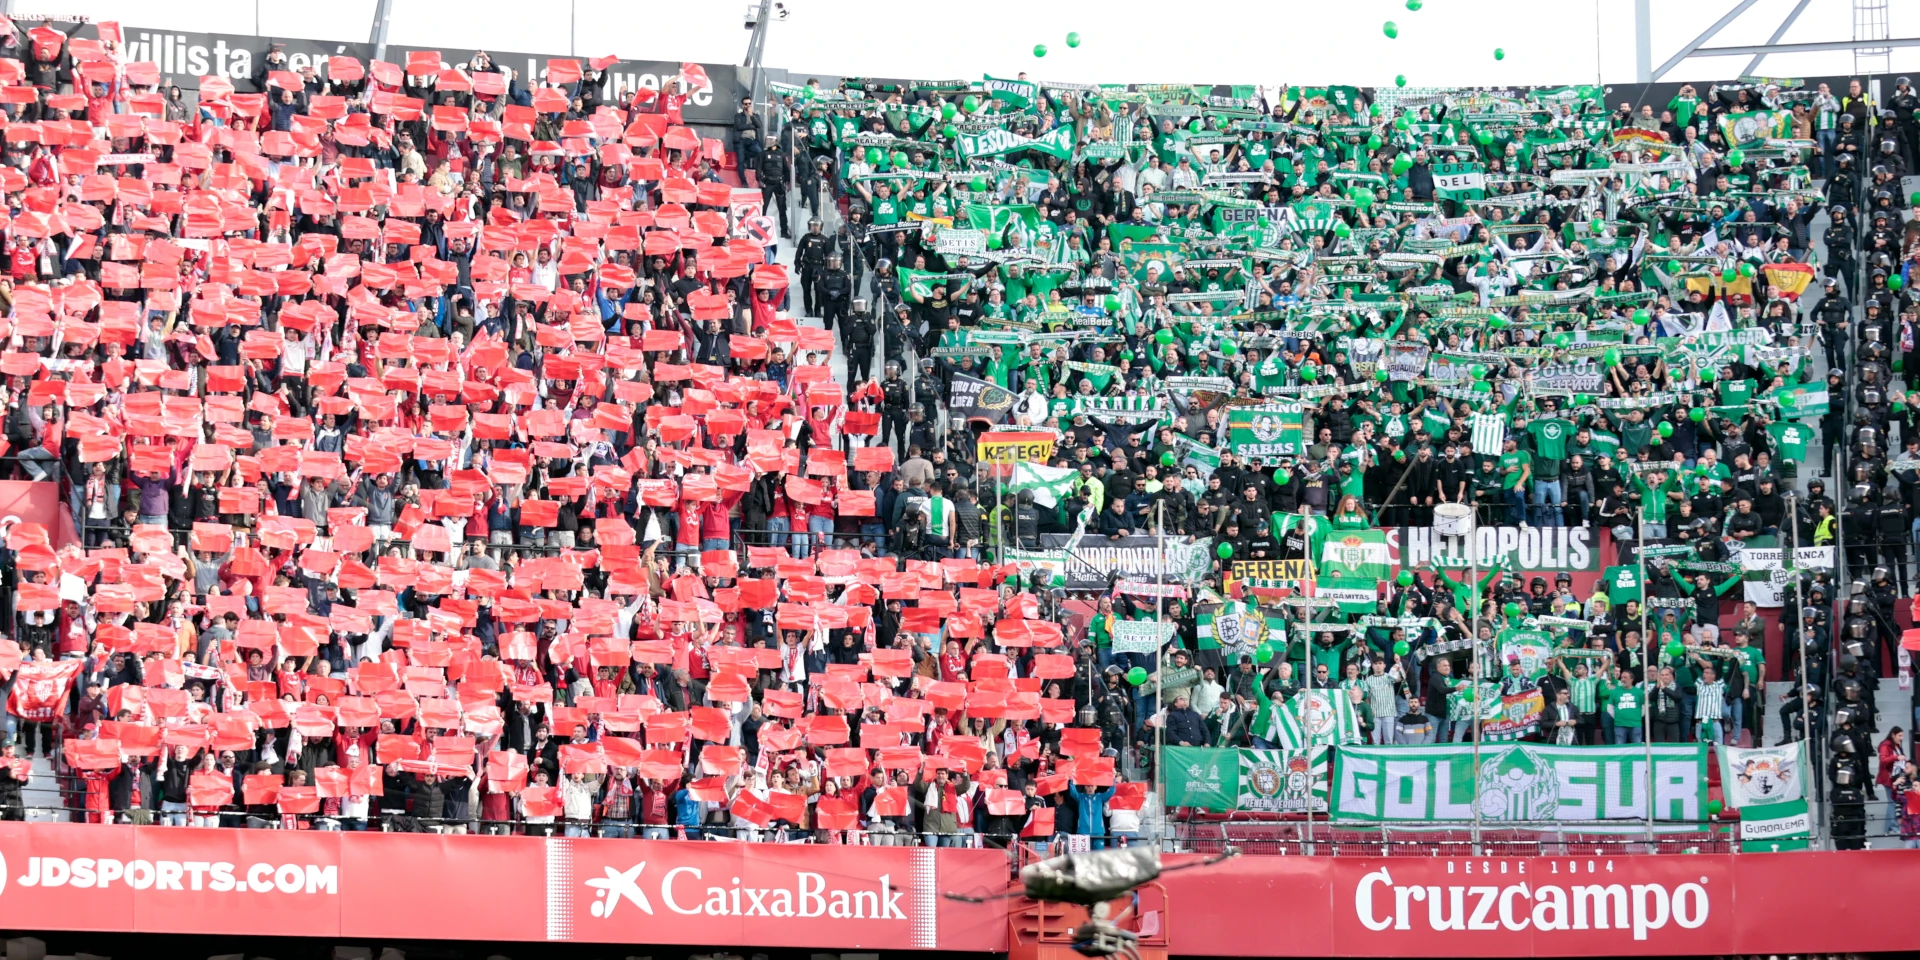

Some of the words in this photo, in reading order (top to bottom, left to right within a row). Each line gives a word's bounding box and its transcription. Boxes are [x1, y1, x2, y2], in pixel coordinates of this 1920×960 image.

[1440, 175, 1471, 187] DEL
[1223, 208, 1288, 222] GERENA
[870, 223, 896, 231] Siempre
[1090, 317, 1112, 326] Betis
[1386, 364, 1423, 373] AGUADULC
[1238, 442, 1294, 455] SABAS
[1750, 550, 1825, 561] TORREBLANCA
[1232, 561, 1316, 580] GERENA
[1706, 562, 1732, 573] Betis
[1253, 579, 1268, 587] REAL
[1271, 580, 1292, 588] BETIS
[1338, 756, 1473, 819] GOL
[1555, 760, 1698, 820] SUR
[1245, 798, 1273, 808] VENENO
[1745, 819, 1804, 834] GUADALEMA
[1447, 861, 1526, 874] DESDE
[1552, 860, 1614, 873] 1904
[17, 856, 338, 895] JDSPORTS.COM
[661, 865, 907, 920] CaixaBank
[1355, 866, 1709, 941] Cruzcampo
